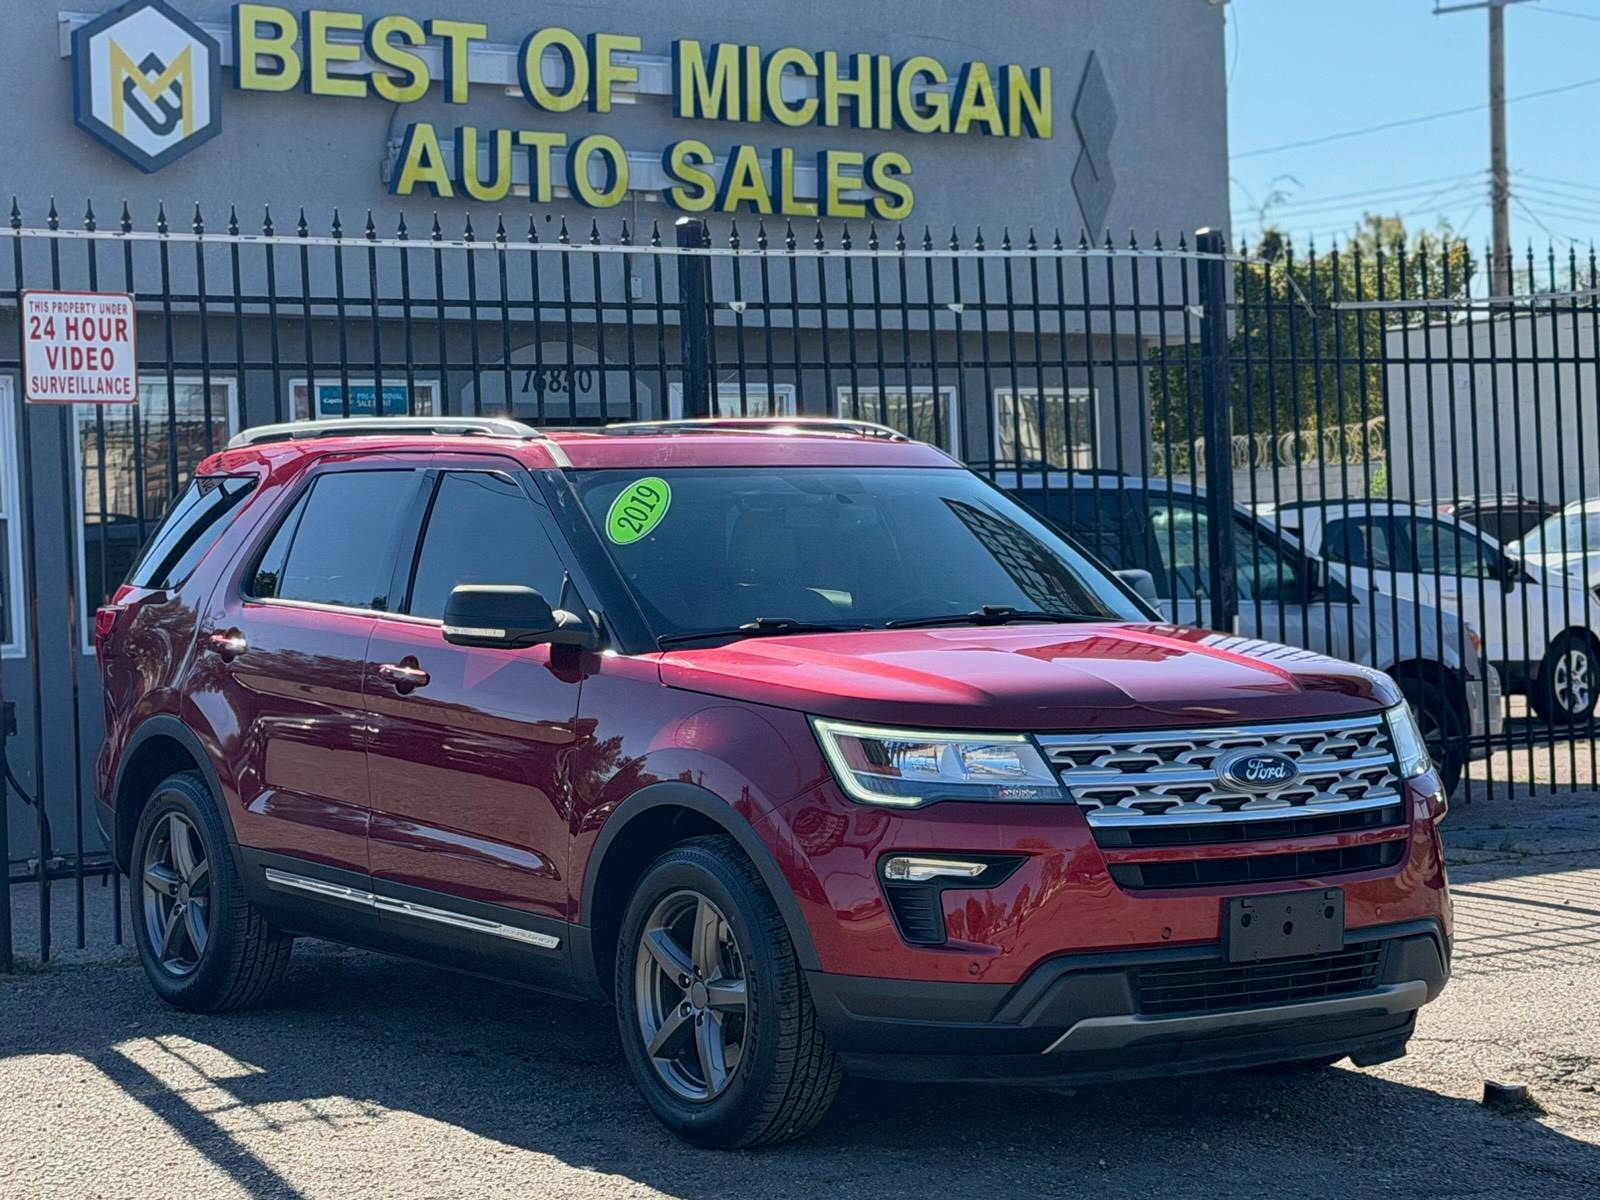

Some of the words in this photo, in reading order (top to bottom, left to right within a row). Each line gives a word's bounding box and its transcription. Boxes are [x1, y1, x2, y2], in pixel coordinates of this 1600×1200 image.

[233, 3, 487, 104] BEST
[518, 27, 641, 113] OF
[672, 39, 1053, 140] MICHIGAN
[390, 122, 630, 208] AUTO
[663, 139, 915, 221] SALES
[29, 300, 49, 313] THIS
[52, 301, 96, 314] PROPERTY
[100, 303, 128, 315] UNDER
[30, 315, 55, 340] 24
[65, 316, 128, 342] HOUR
[45, 345, 115, 371] VIDEO
[32, 376, 131, 395] SURVEILLANCE
[617, 485, 660, 534] 2019
[1245, 758, 1287, 780] Ford
